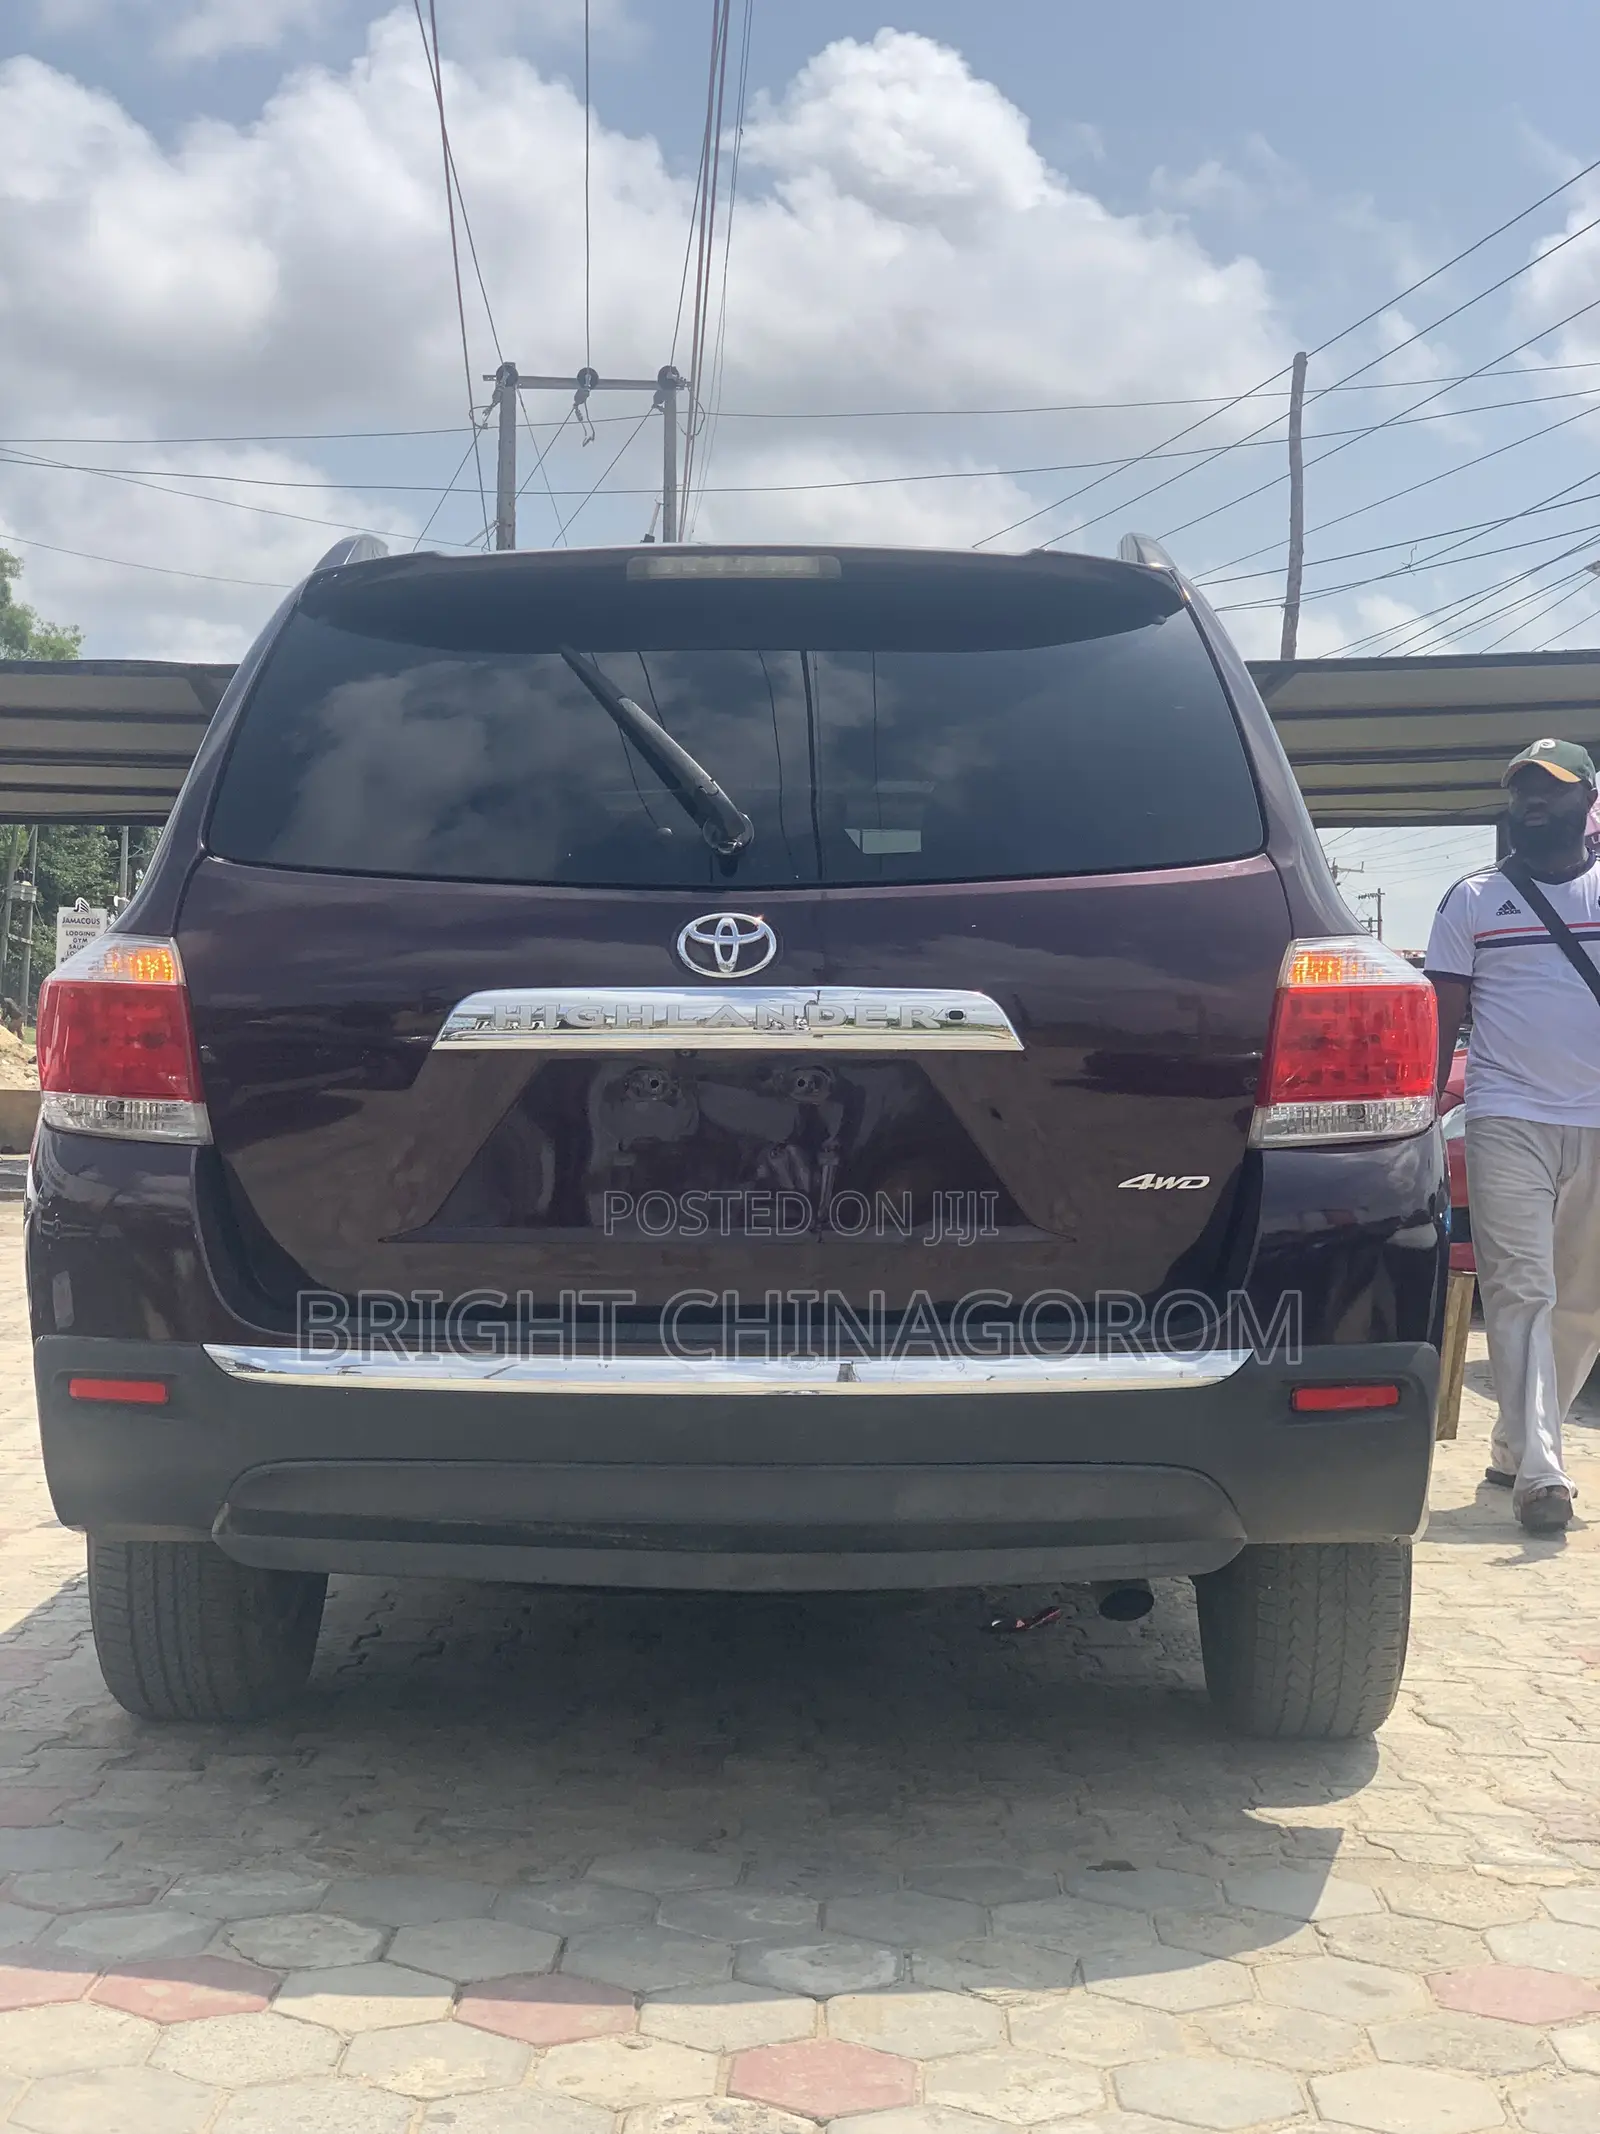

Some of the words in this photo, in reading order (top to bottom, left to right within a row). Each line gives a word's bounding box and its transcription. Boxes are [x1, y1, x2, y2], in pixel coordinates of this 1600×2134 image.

[1495, 907, 1521, 916] adidas
[497, 1003, 941, 1030] HIGHLANDER
[1117, 1172, 1211, 1190] 4WD
